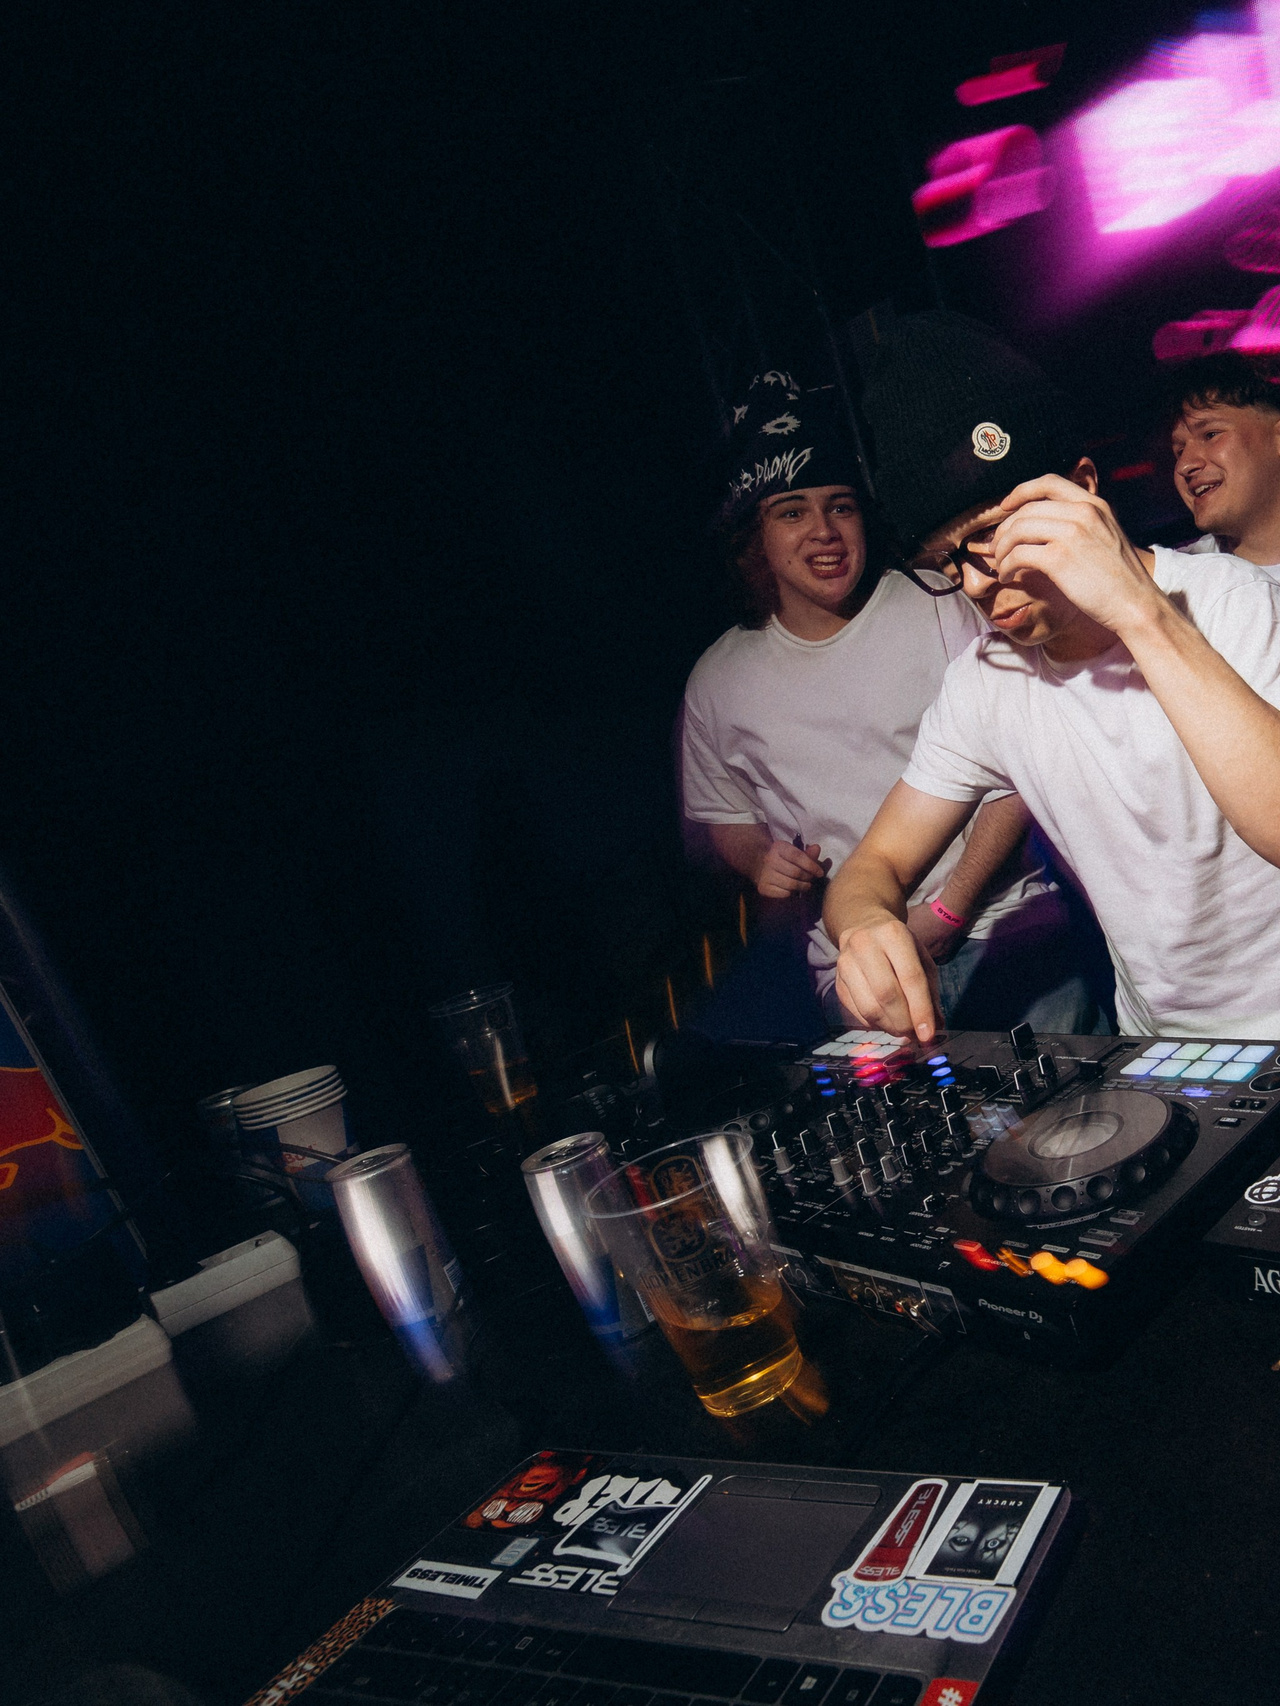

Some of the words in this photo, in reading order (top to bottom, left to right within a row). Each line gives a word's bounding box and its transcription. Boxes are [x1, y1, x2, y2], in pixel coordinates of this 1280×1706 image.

[978, 1298, 1026, 1318] Pioneer
[1029, 1310, 1043, 1324] DJ
[977, 1498, 1024, 1507] CHUCKY
[404, 1567, 489, 1589] TIMELESS
[507, 1563, 620, 1596] BLESS
[828, 1580, 1009, 1636] BLESS
